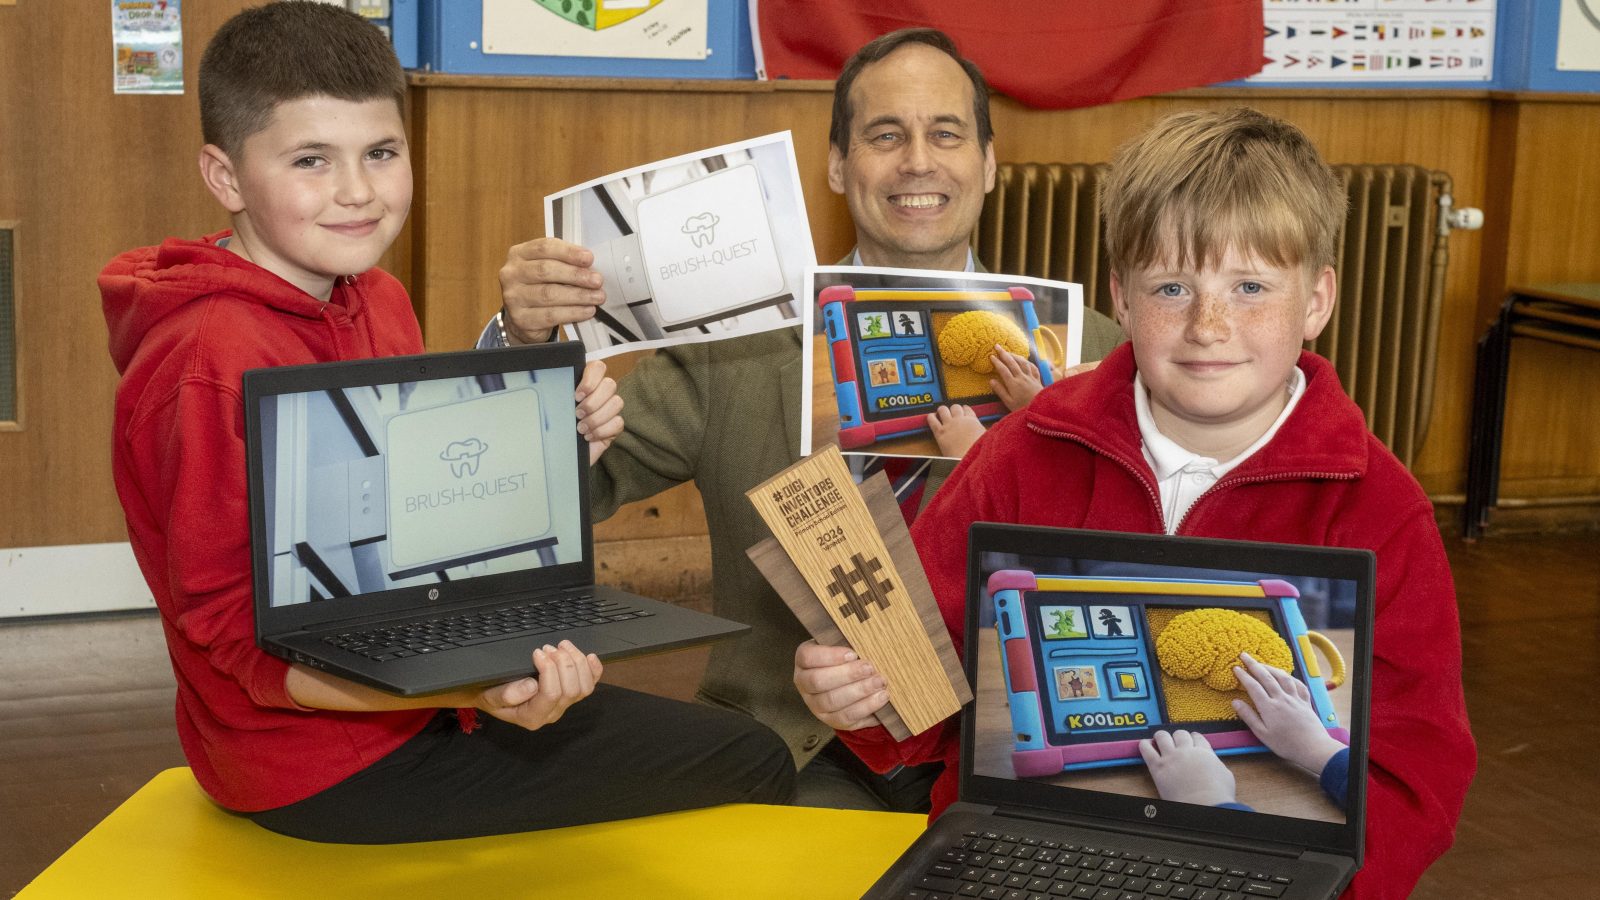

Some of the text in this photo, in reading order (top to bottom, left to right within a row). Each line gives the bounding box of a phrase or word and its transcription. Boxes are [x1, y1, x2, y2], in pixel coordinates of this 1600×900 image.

[659, 238, 759, 281] BRUSH-QUEST
[405, 472, 529, 514] BRUSH-QUEST
[772, 478, 805, 503] #DIGI
[779, 477, 835, 517] INVENTORS
[786, 488, 843, 528] CHALLENGE
[816, 525, 844, 547] 2026
